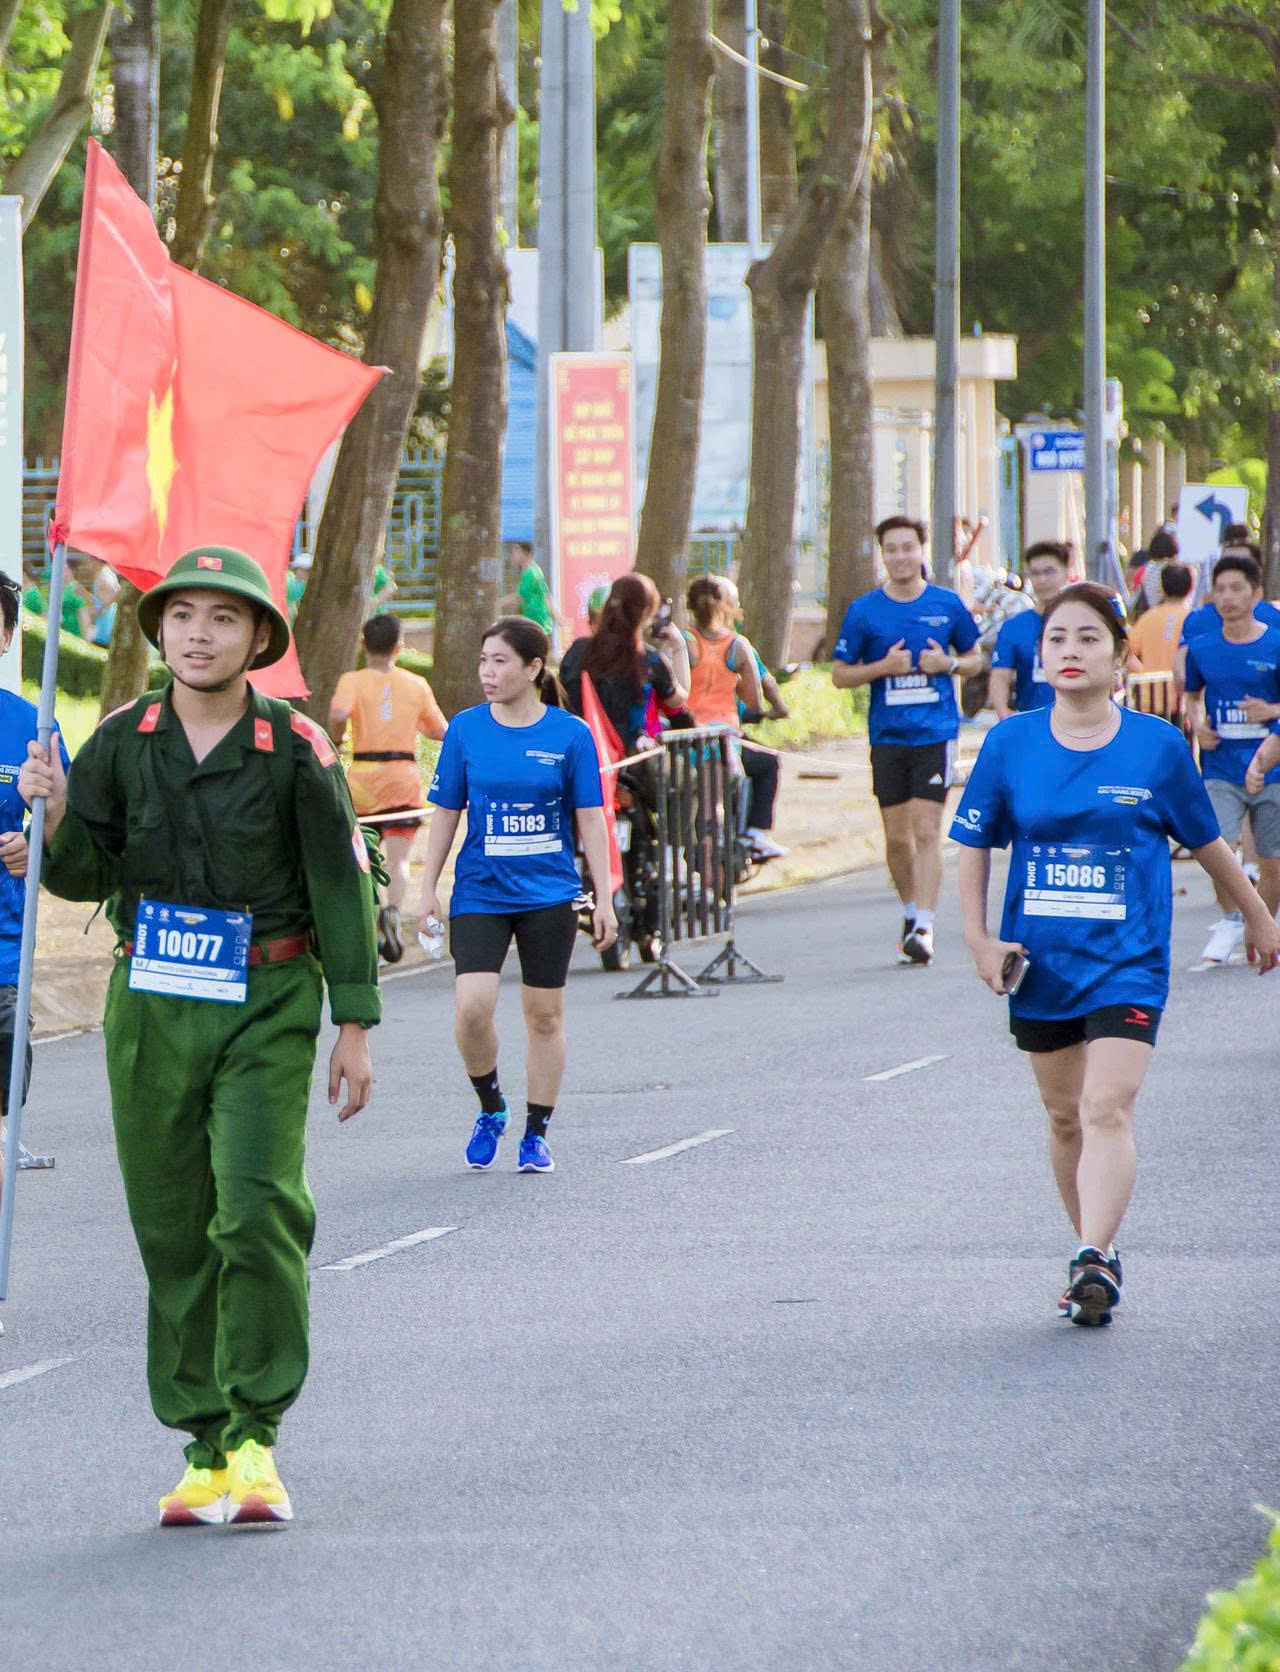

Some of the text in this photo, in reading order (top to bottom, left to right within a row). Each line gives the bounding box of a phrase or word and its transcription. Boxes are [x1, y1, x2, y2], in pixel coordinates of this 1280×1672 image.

[502, 814, 545, 833] 15183
[1027, 861, 1106, 888] 10KM 15086
[136, 923, 223, 962] 10KM 10077
